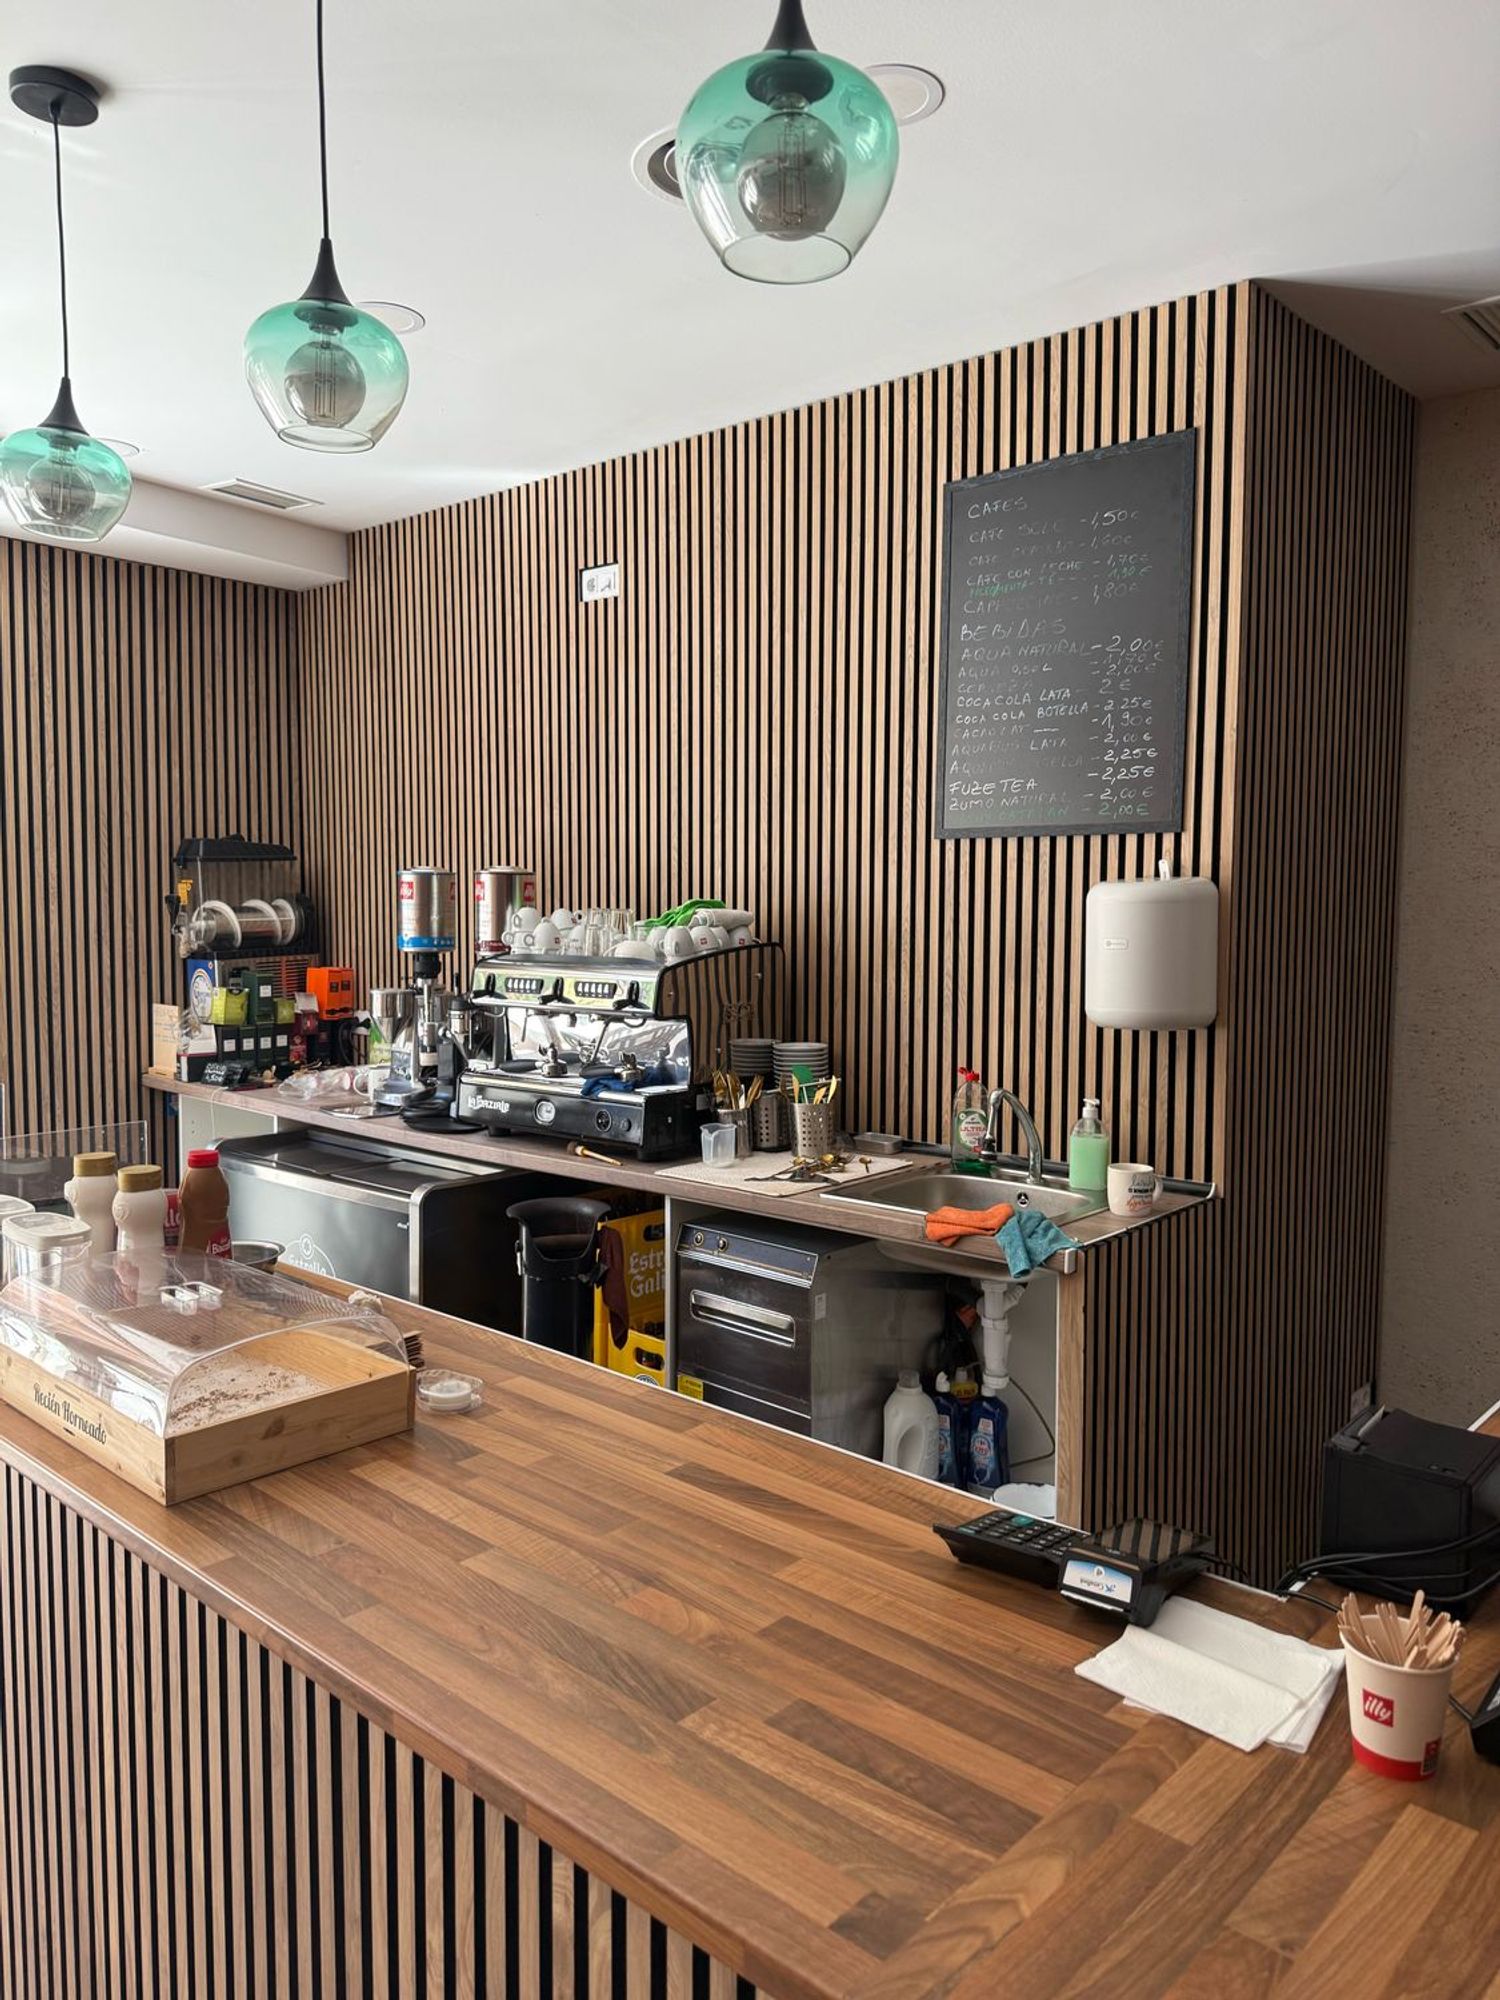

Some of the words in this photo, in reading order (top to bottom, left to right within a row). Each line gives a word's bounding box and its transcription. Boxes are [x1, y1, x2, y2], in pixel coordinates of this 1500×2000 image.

[1007, 568, 1031, 579] CON
[960, 618, 1067, 642] BEBIDAS
[956, 696, 991, 709] COCA
[994, 693, 1032, 706] COLA
[1040, 688, 1071, 702] LATA
[955, 715, 987, 725] COCA
[993, 710, 1026, 721] COLA
[1036, 702, 1088, 719] BOTELLA
[949, 780, 995, 796] FUZE
[999, 778, 1036, 793] TEA
[949, 797, 993, 811] ZUMO
[33, 1382, 61, 1417] Recién
[61, 1400, 107, 1445] Horneado
[1364, 1696, 1392, 1721] illy
